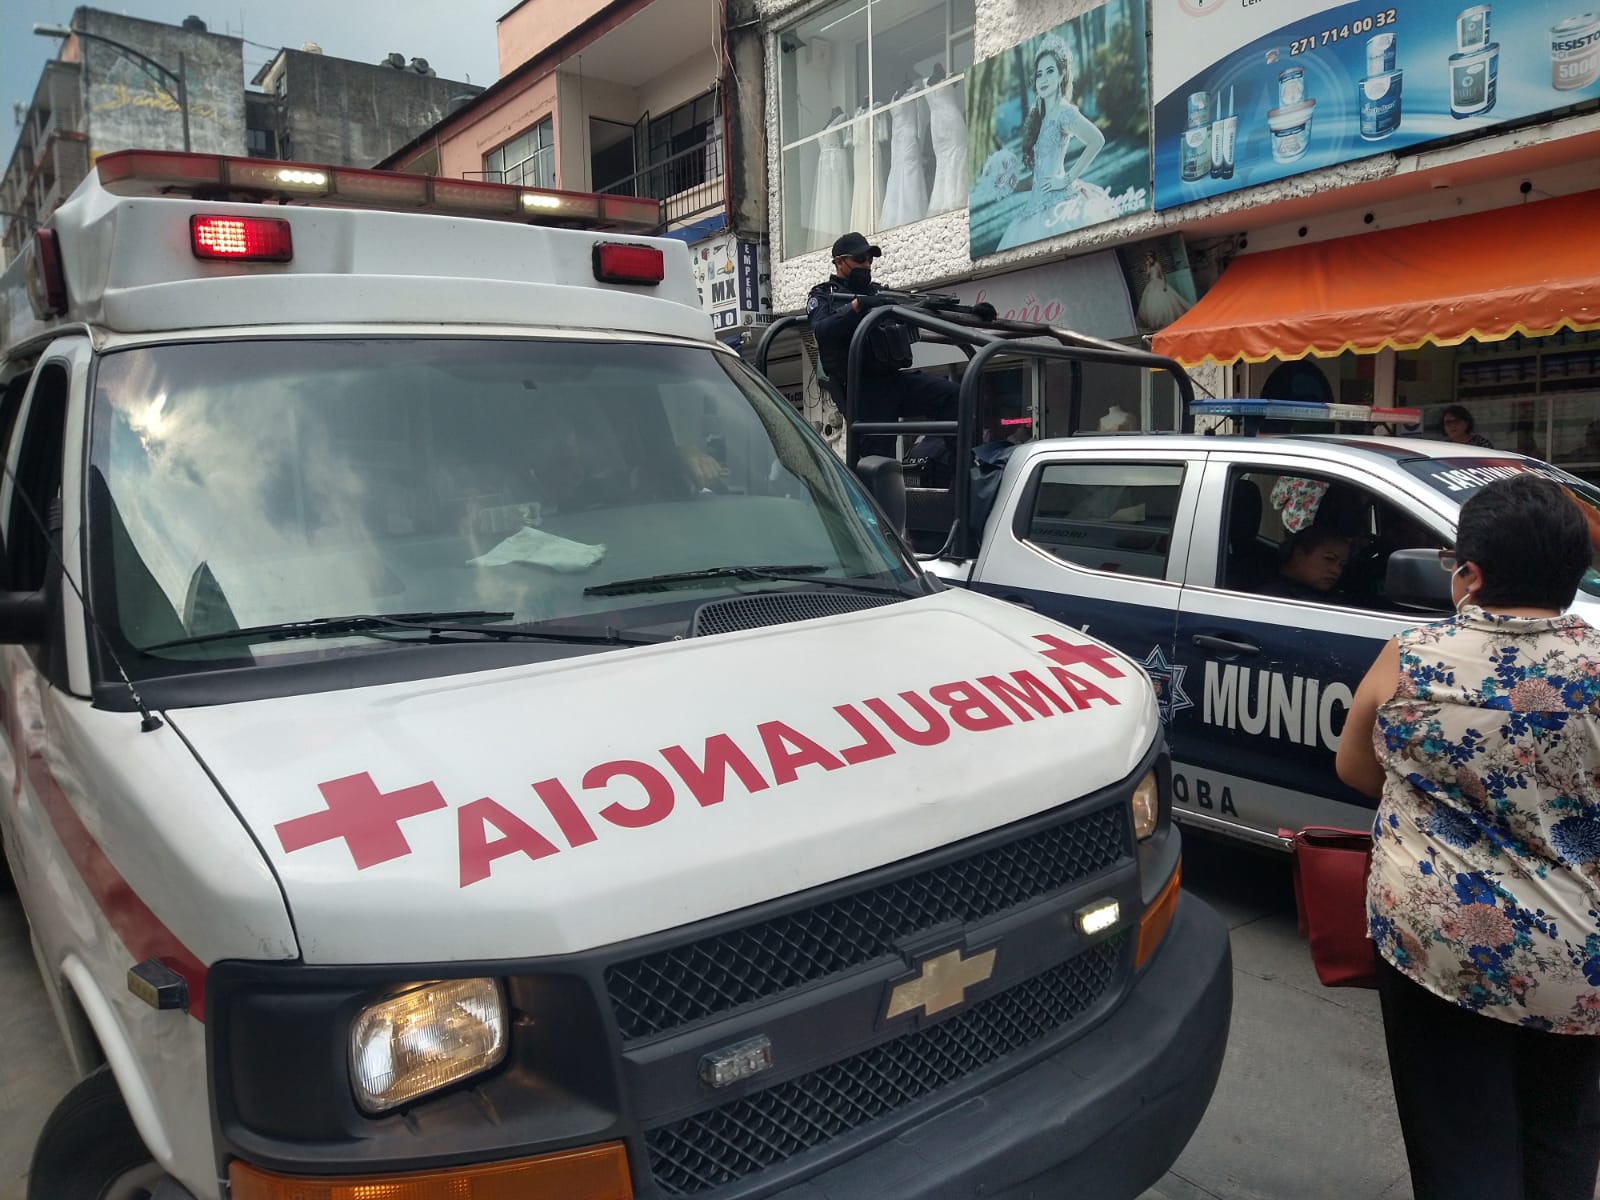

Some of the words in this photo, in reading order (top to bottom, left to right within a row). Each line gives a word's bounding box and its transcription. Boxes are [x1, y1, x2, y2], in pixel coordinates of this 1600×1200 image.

[1290, 35, 1316, 56] 271
[1321, 24, 1350, 46] 714
[1352, 17, 1373, 34] 00
[1375, 9, 1396, 27] 32
[711, 278, 736, 303] MX
[1203, 660, 1353, 753] MUNIC
[1173, 773, 1239, 818] OBA
